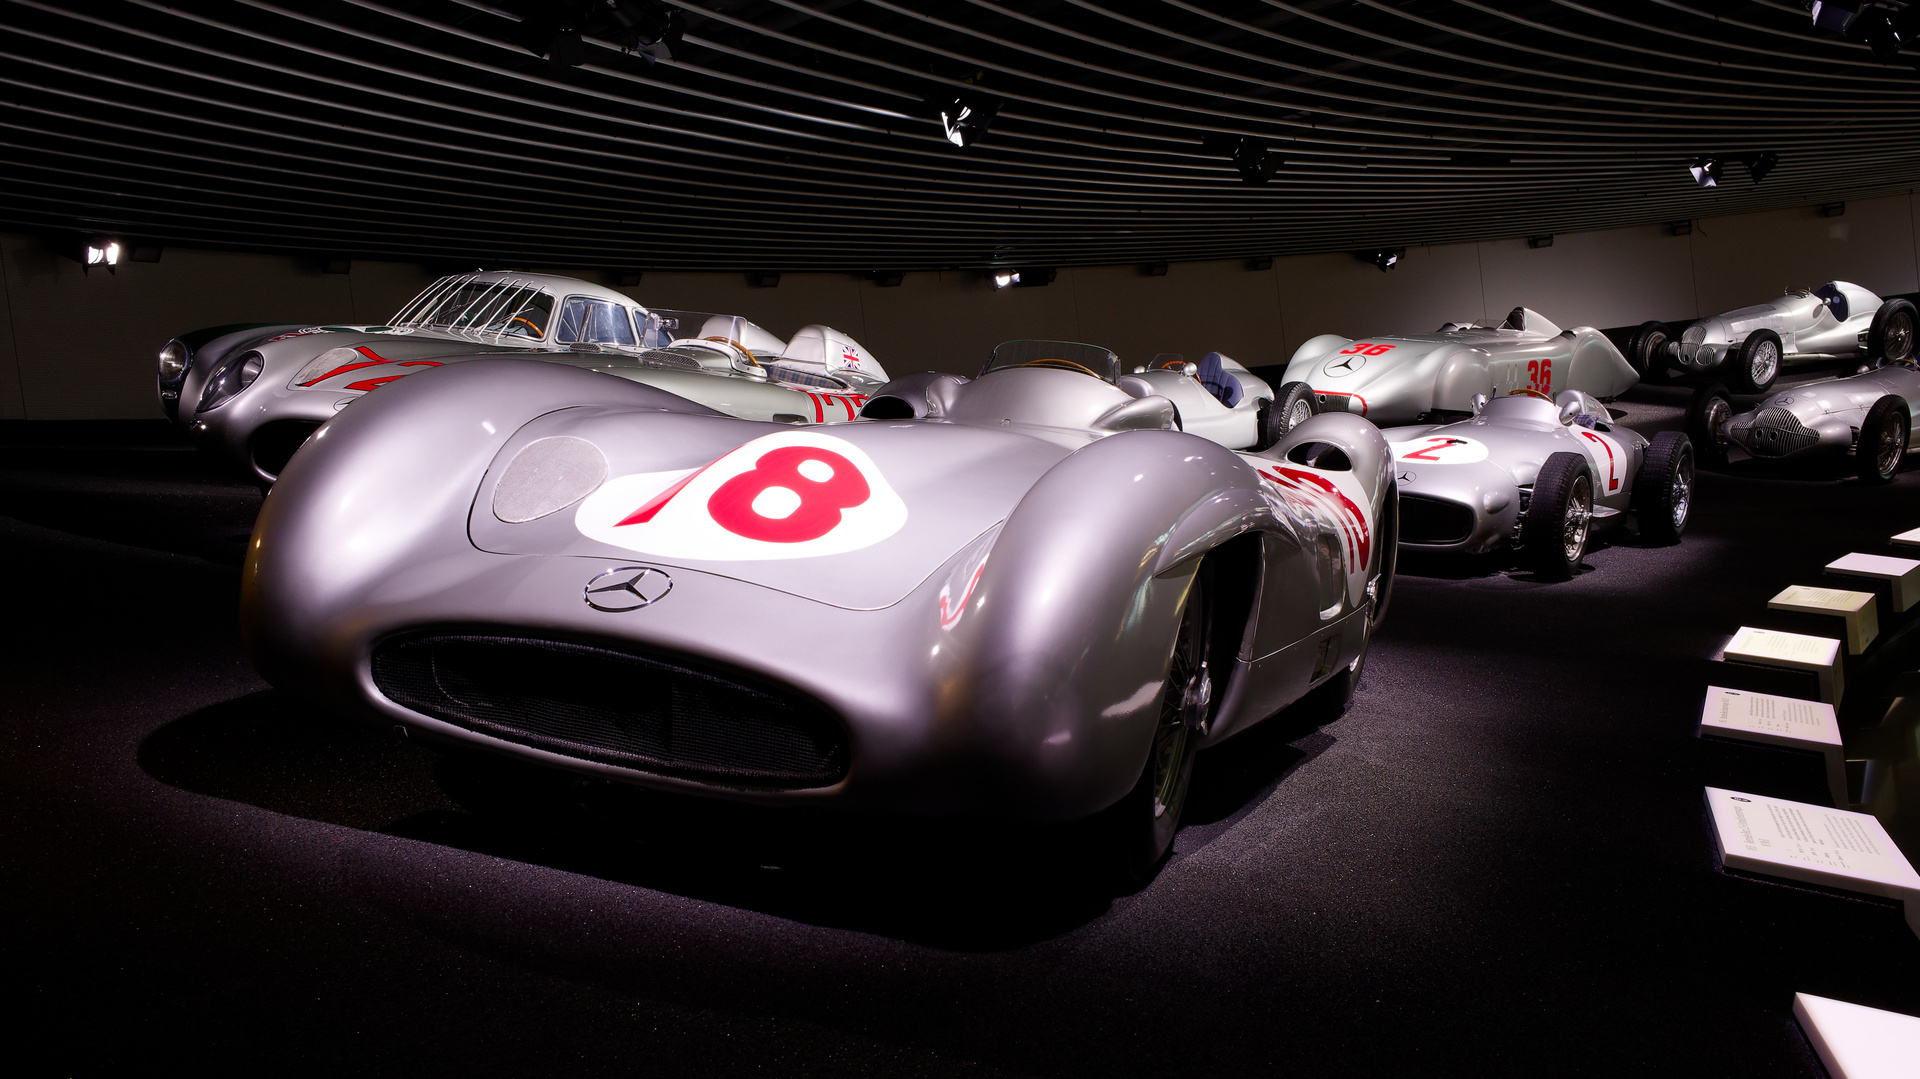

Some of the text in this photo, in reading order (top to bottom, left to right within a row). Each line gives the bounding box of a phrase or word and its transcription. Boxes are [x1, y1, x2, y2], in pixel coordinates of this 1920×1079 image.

[1340, 343, 1396, 356] 36
[1527, 359, 1552, 397] 36
[1402, 437, 1457, 461] 2
[1581, 431, 1619, 491] 2
[612, 444, 871, 544] 18
